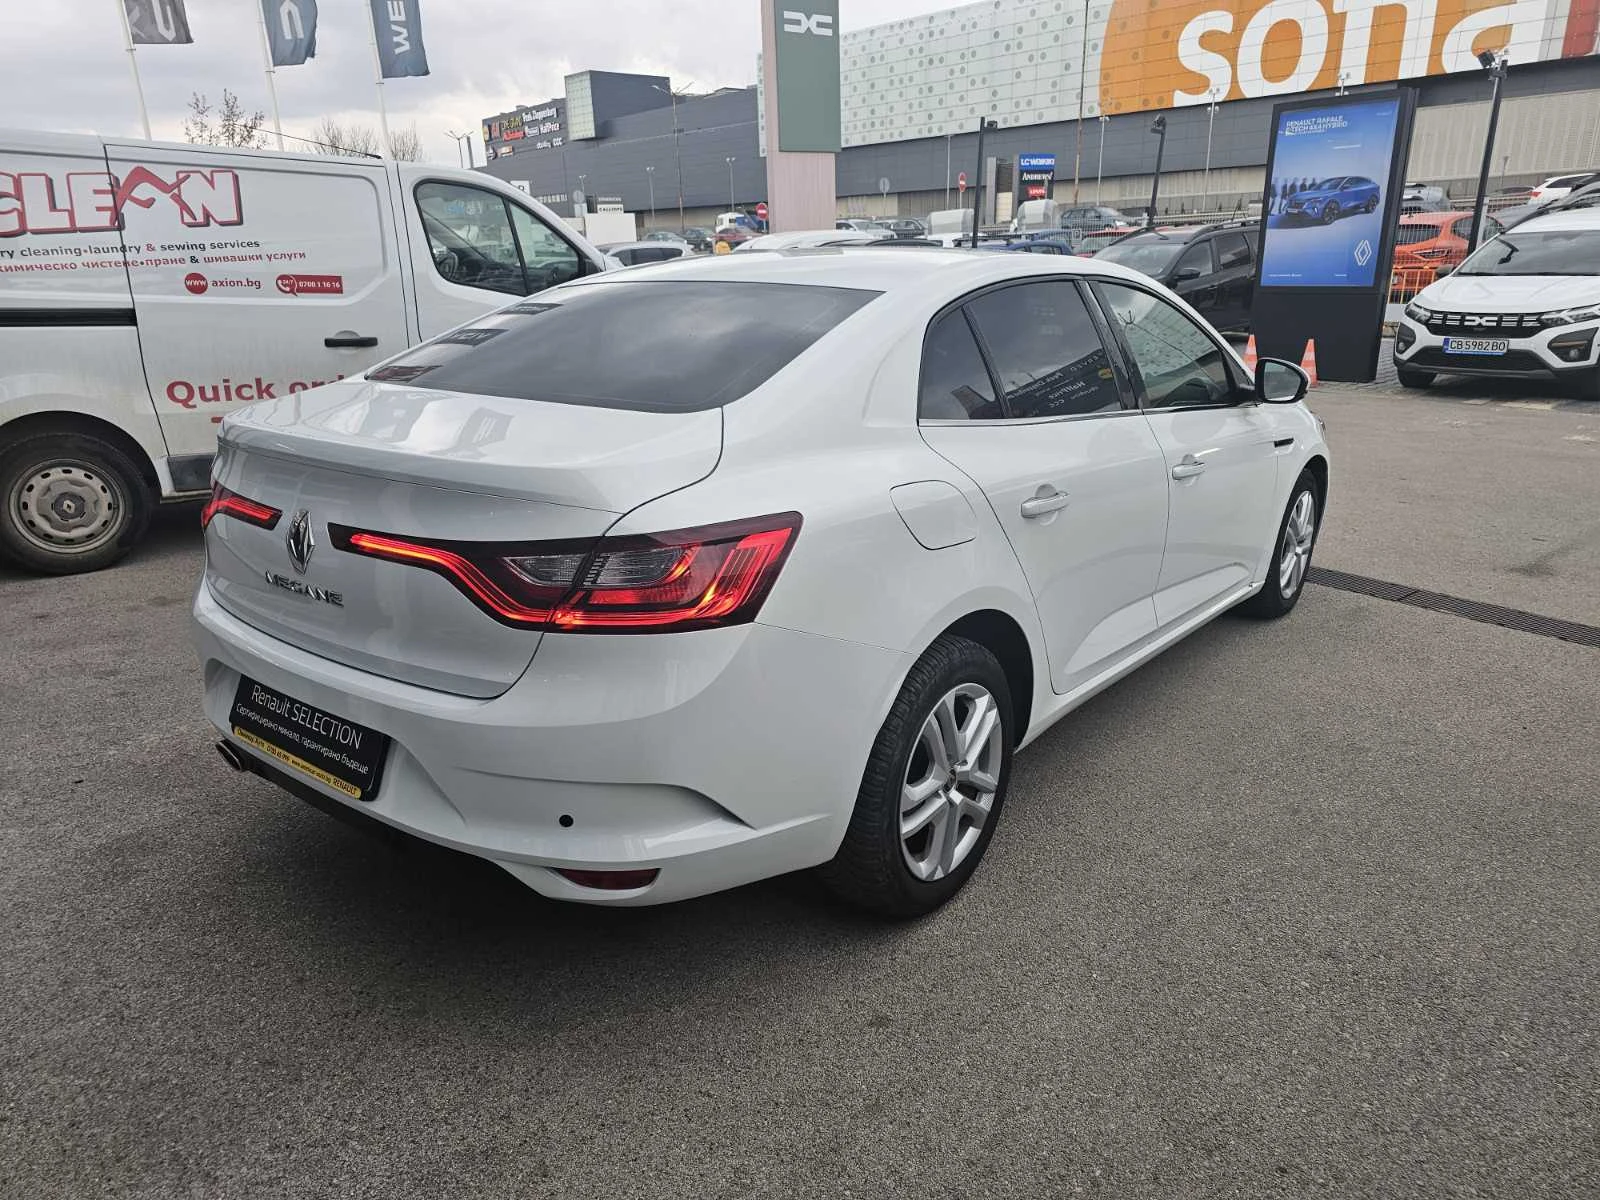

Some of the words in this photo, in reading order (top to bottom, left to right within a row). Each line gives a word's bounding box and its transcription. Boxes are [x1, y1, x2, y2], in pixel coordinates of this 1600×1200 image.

[0, 249, 14, 259] ry
[160, 240, 206, 251] sewing
[209, 239, 260, 249] services
[203, 253, 263, 263] шивашки
[265, 250, 306, 263] услуги
[185, 279, 207, 287] www
[211, 277, 261, 289] axion.bg
[1465, 340, 1489, 351] 5982
[166, 377, 277, 409] Quick
[265, 570, 344, 608] MEGANE
[251, 684, 291, 718] Renault
[291, 703, 363, 750] SELECTION
[341, 753, 369, 775] бъдеще
